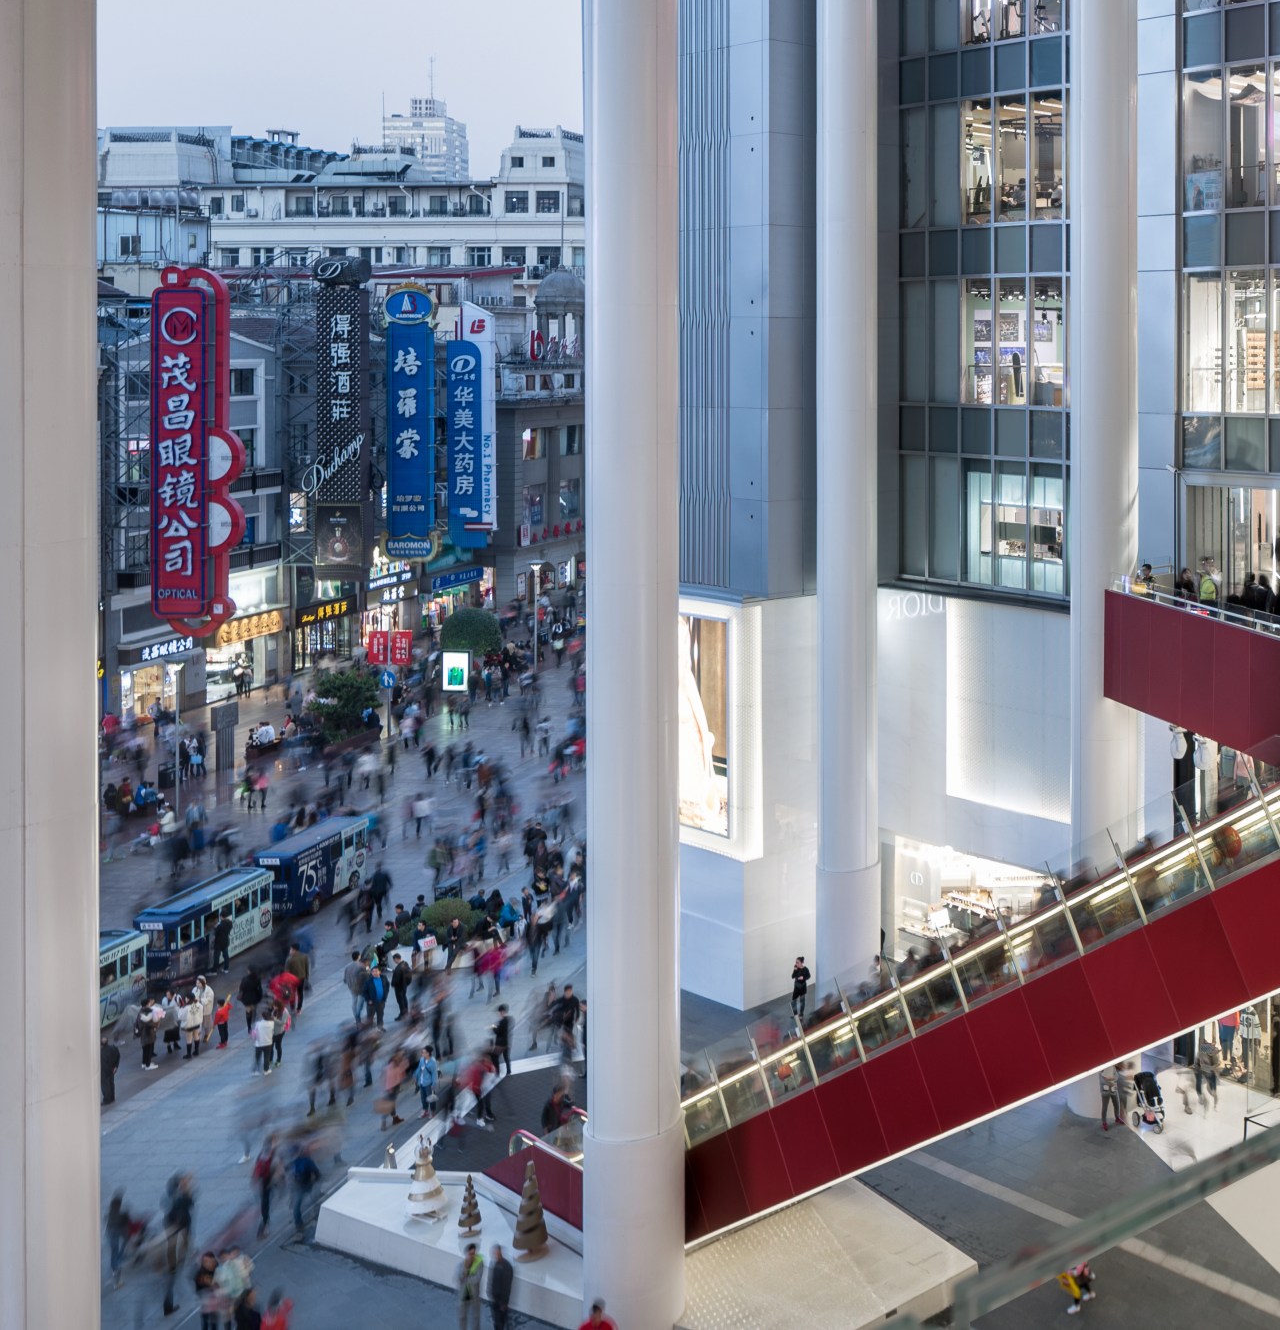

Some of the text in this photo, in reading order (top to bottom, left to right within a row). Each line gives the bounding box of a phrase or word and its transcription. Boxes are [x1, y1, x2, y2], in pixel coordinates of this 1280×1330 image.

[158, 352, 199, 576] 茂昌眼镜公司
[301, 432, 365, 497] Duchamp
[454, 386, 475, 496] 华美大药房
[482, 435, 492, 515] No.1 Pharmacy
[388, 541, 431, 550] BAROMON
[158, 588, 198, 599] OPTICAL
